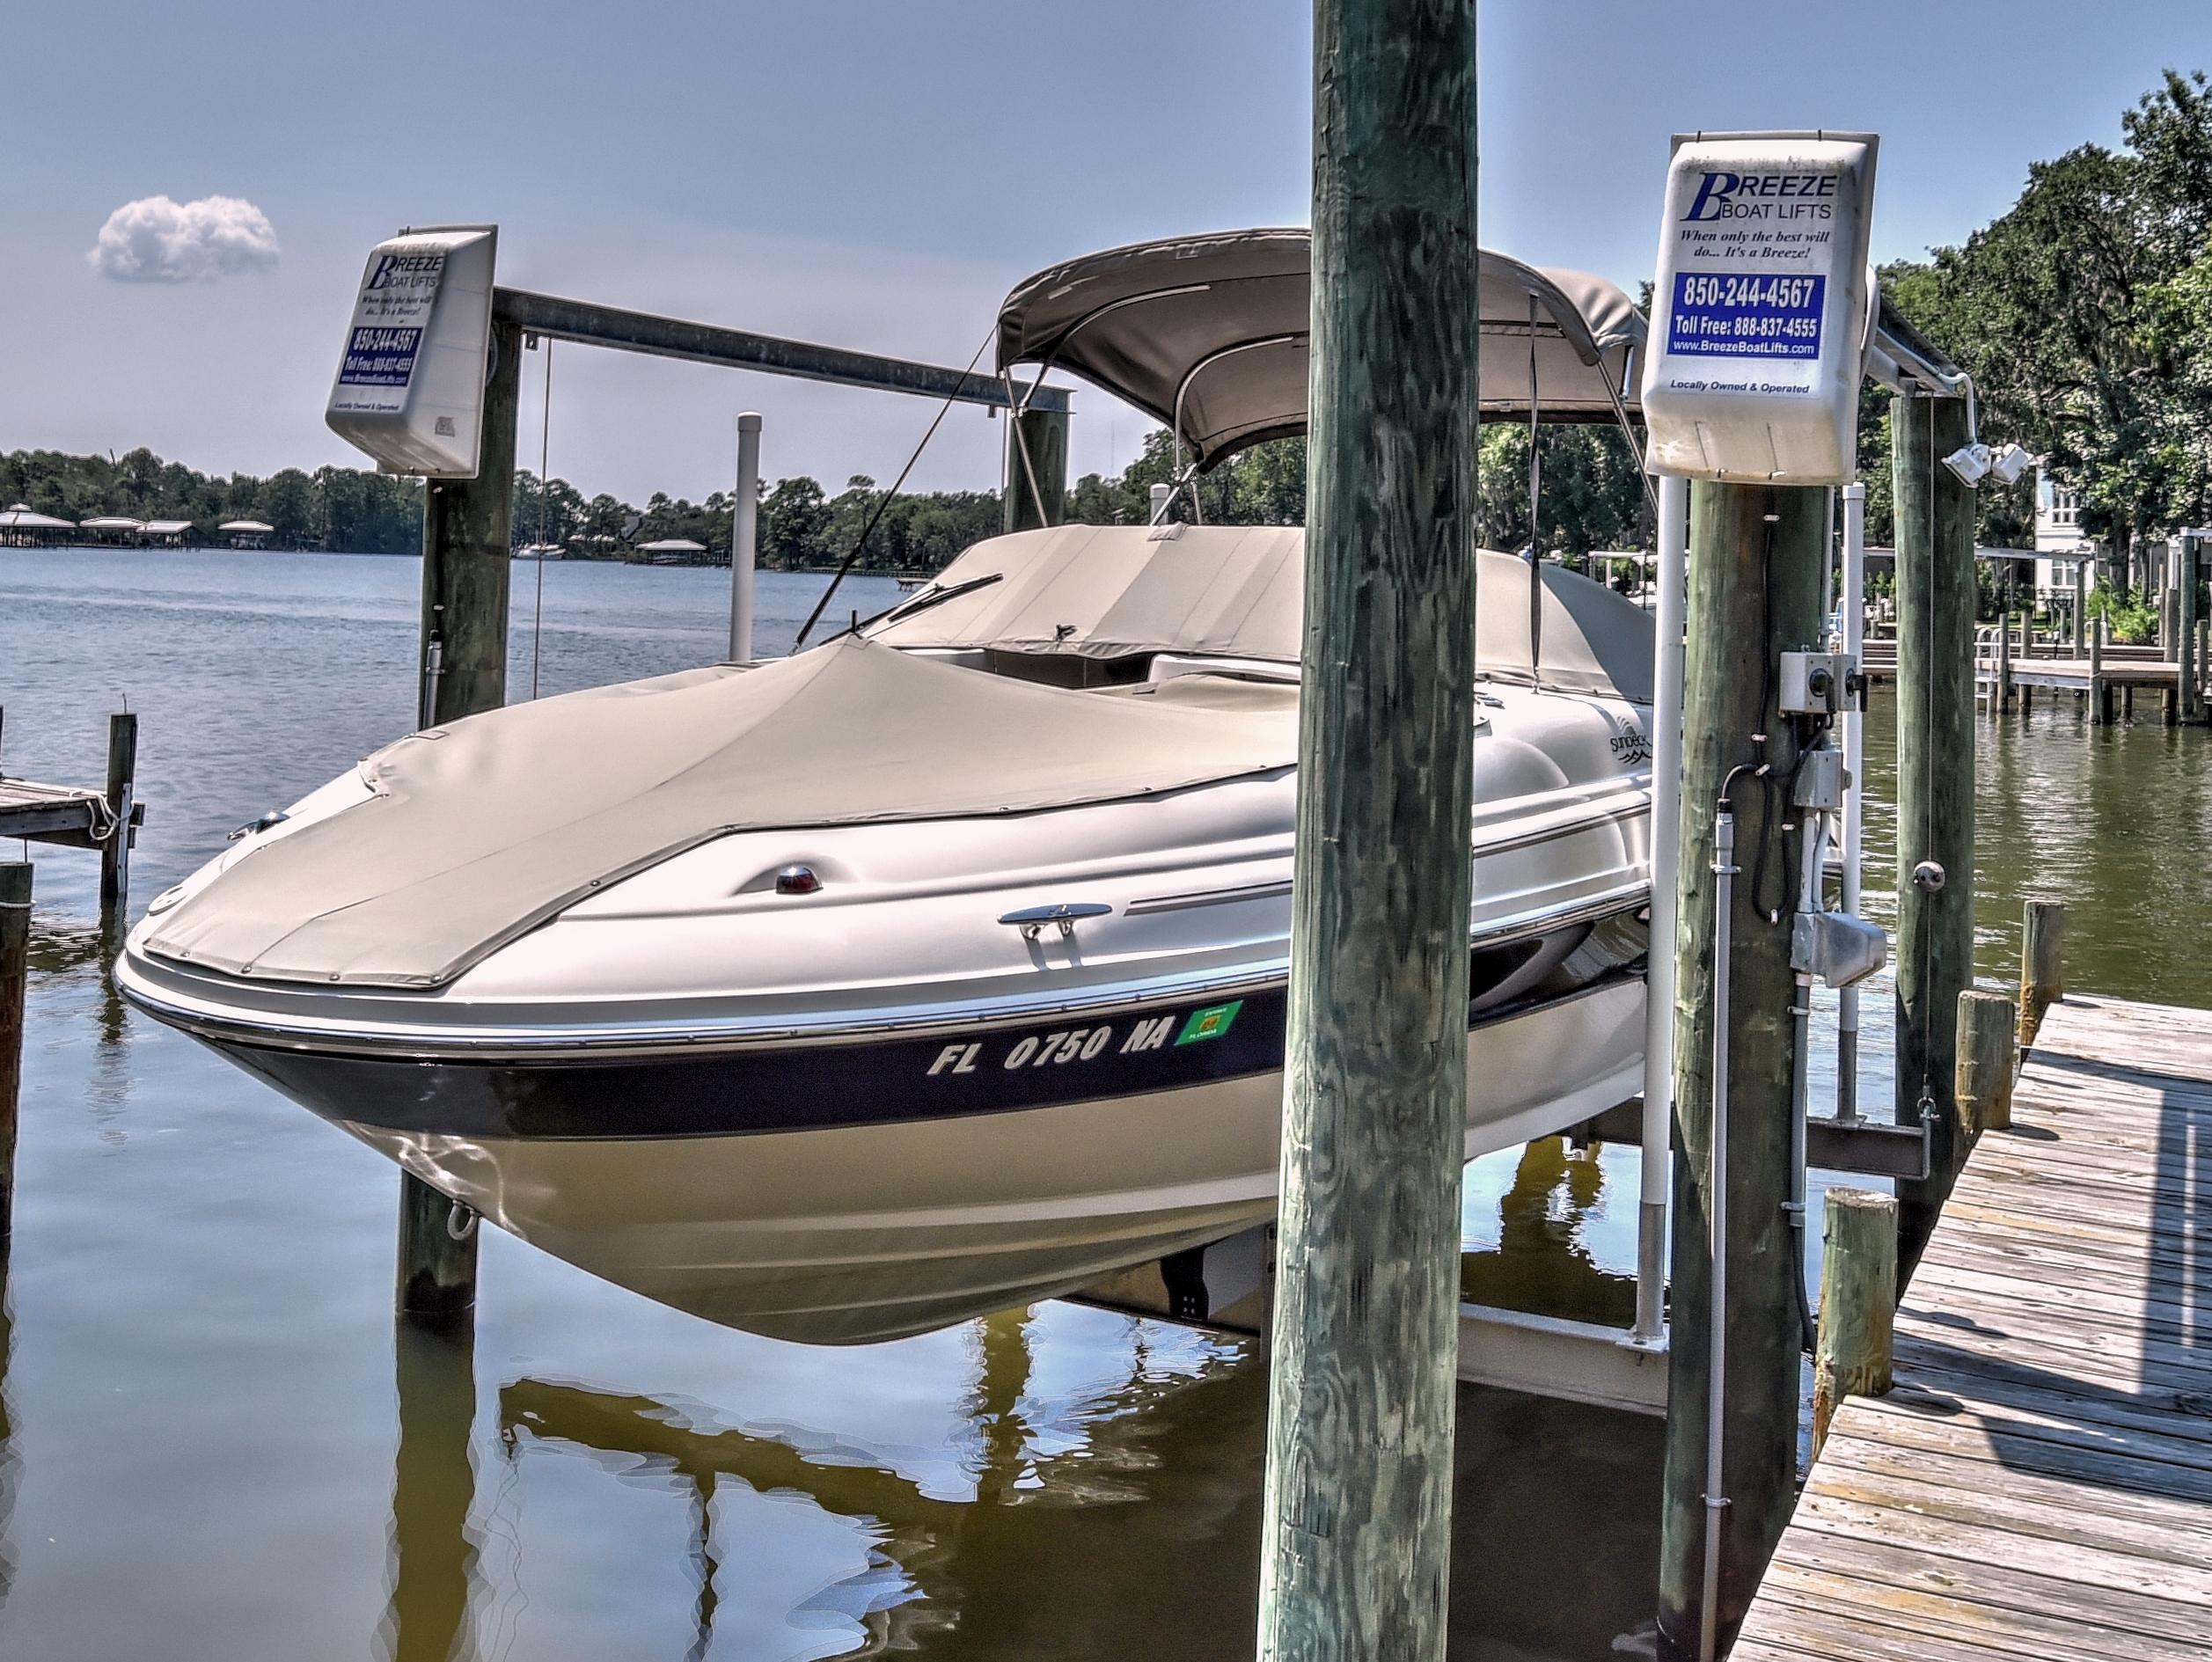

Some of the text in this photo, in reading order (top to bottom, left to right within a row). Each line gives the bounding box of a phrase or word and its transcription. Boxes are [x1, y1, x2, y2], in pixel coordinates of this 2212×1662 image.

[1680, 172, 1838, 223] BREEZE
[1721, 203, 1832, 220] BOAT LIFTS
[1681, 230, 1830, 245] When only the best will
[1694, 246, 1720, 259] do...
[1725, 247, 1746, 258] It's
[1762, 247, 1811, 259] Breeze!
[364, 255, 444, 290] BREEZE
[384, 276, 436, 288] BOAT LIFTS
[1685, 276, 1816, 308] 850-244-4567
[1675, 314, 1818, 338] Toll Free: 888-837-4555
[354, 329, 417, 351] 850-244-4567
[1673, 340, 1815, 355] www.BreezeBoatLifts.com
[1670, 379, 1810, 393] Locally Owned & Operated
[927, 1015, 1176, 1076] FL 0750 NA
